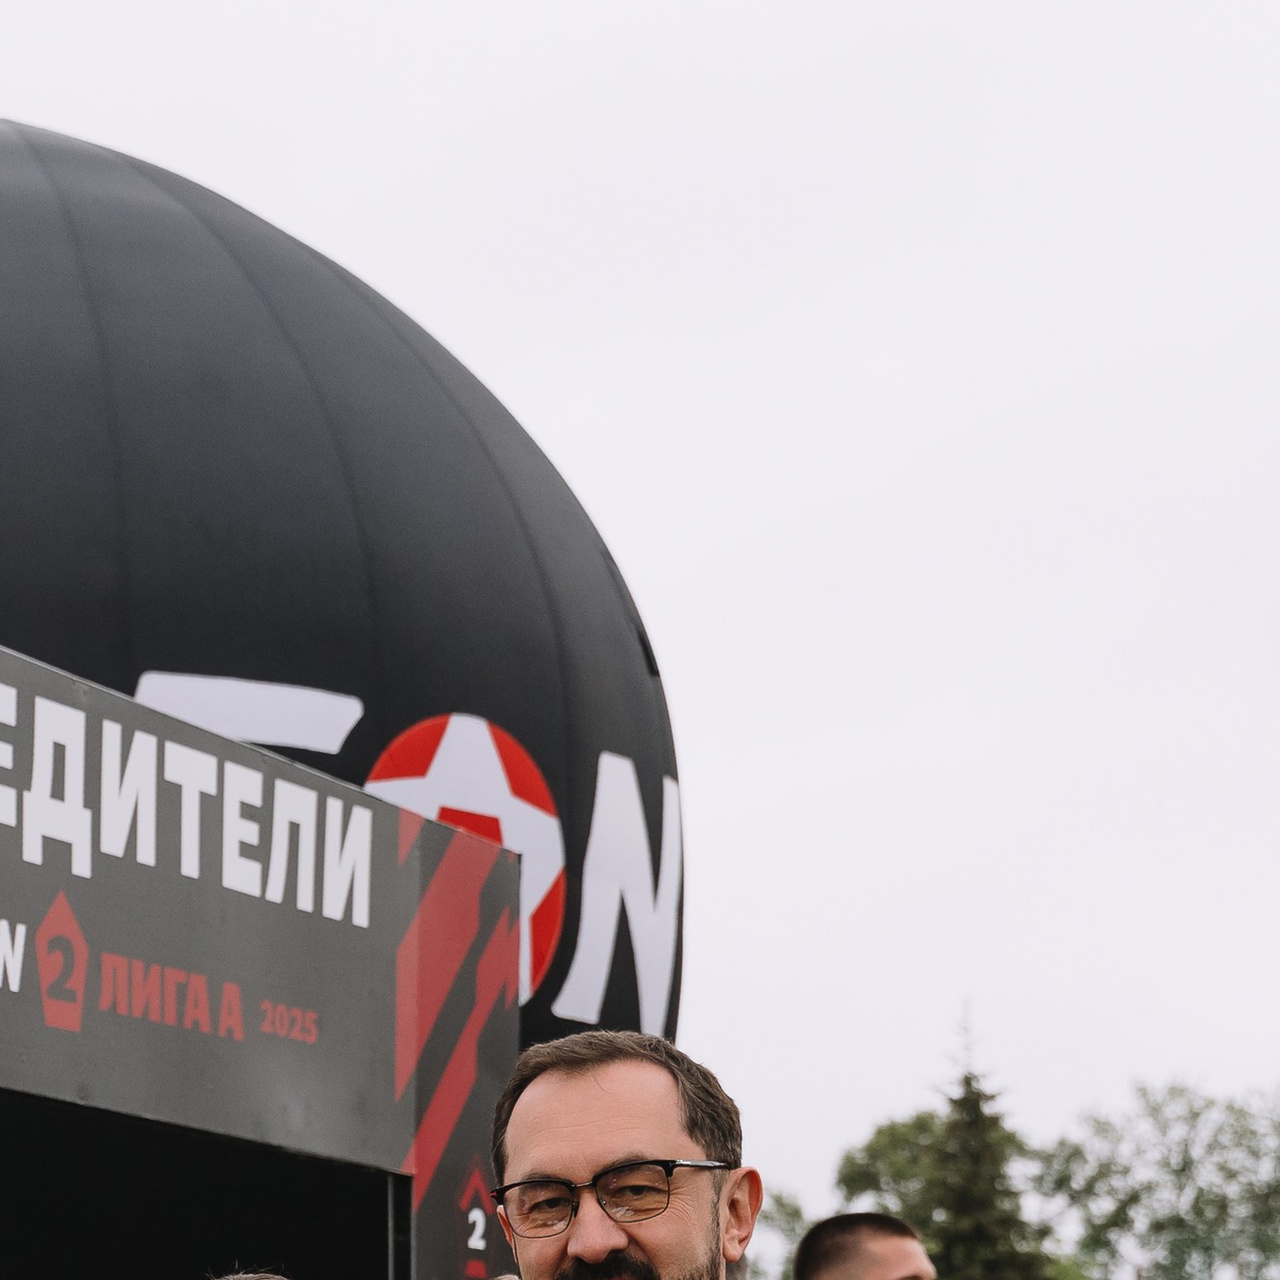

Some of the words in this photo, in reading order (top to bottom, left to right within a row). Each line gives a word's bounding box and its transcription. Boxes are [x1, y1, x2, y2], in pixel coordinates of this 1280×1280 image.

[46, 935, 78, 1002] 2
[99, 952, 211, 1034] ЛИГА
[218, 981, 245, 1041] А
[259, 1000, 319, 1045] 2025
[467, 1207, 487, 1250] 2
